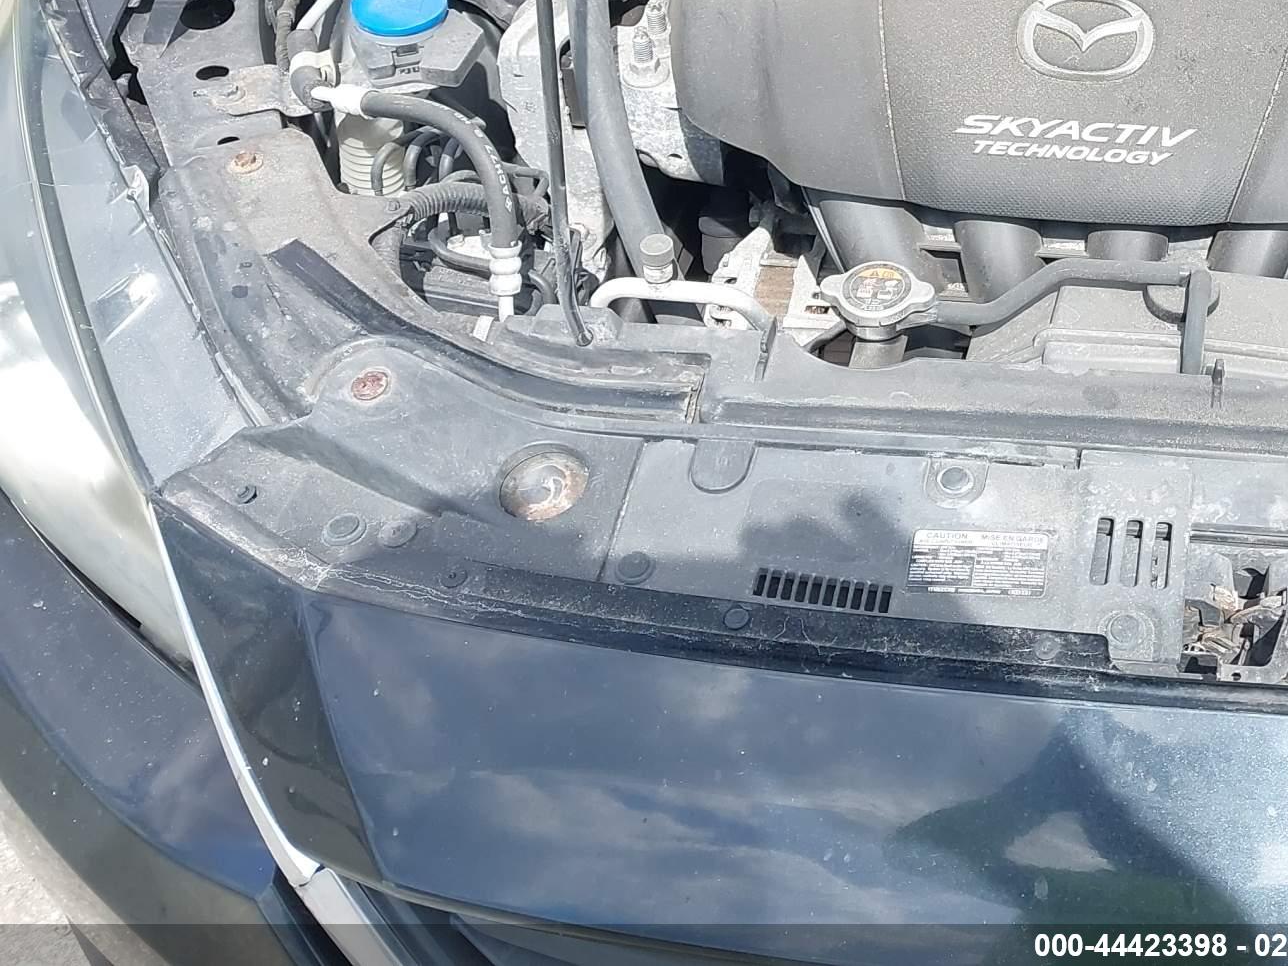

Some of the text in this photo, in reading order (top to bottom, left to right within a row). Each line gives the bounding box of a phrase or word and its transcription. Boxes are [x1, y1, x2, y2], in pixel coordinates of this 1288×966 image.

[953, 114, 1198, 147] SKYACTIV
[973, 140, 1173, 166] TECHNOLOGY
[926, 532, 968, 540] CAUTION
